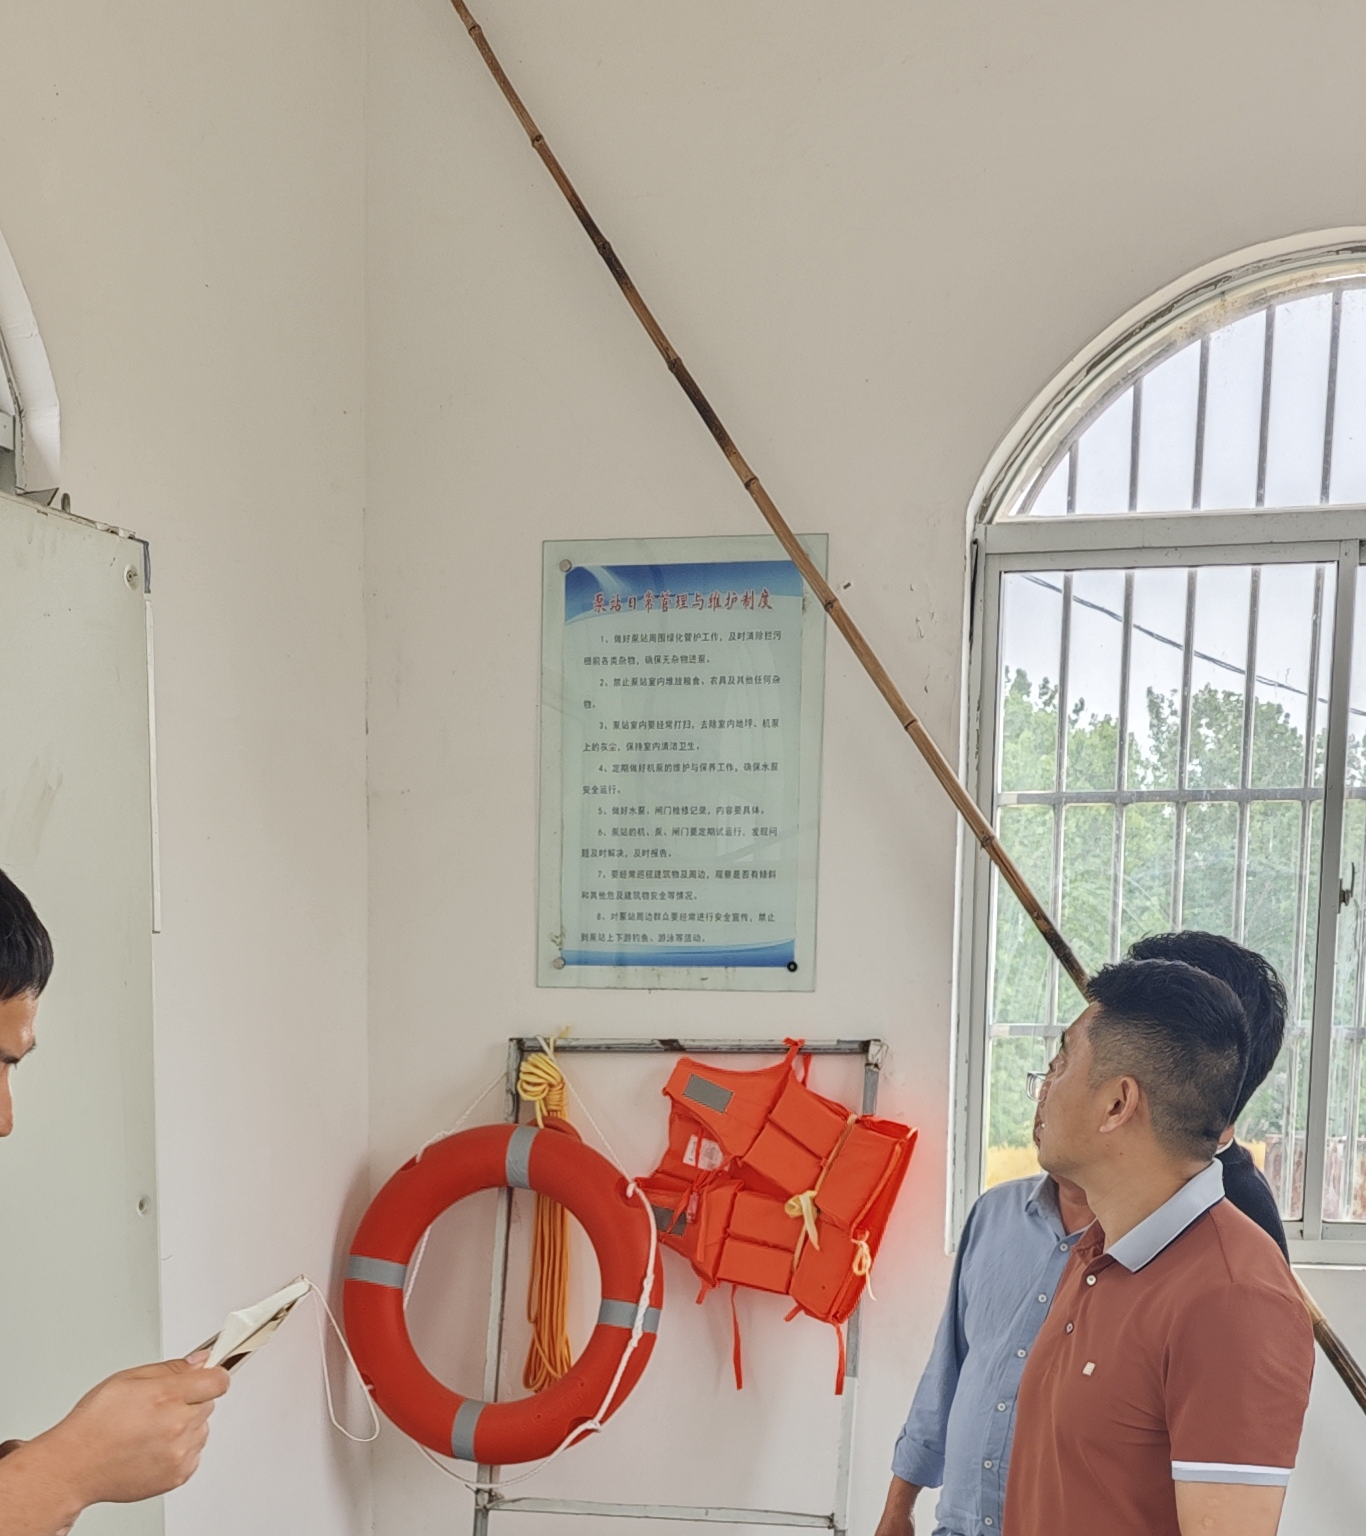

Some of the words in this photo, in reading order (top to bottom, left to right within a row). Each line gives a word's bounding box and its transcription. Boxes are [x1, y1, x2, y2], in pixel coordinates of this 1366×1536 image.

[592, 588, 773, 614] 泵站日常管理与维护制度
